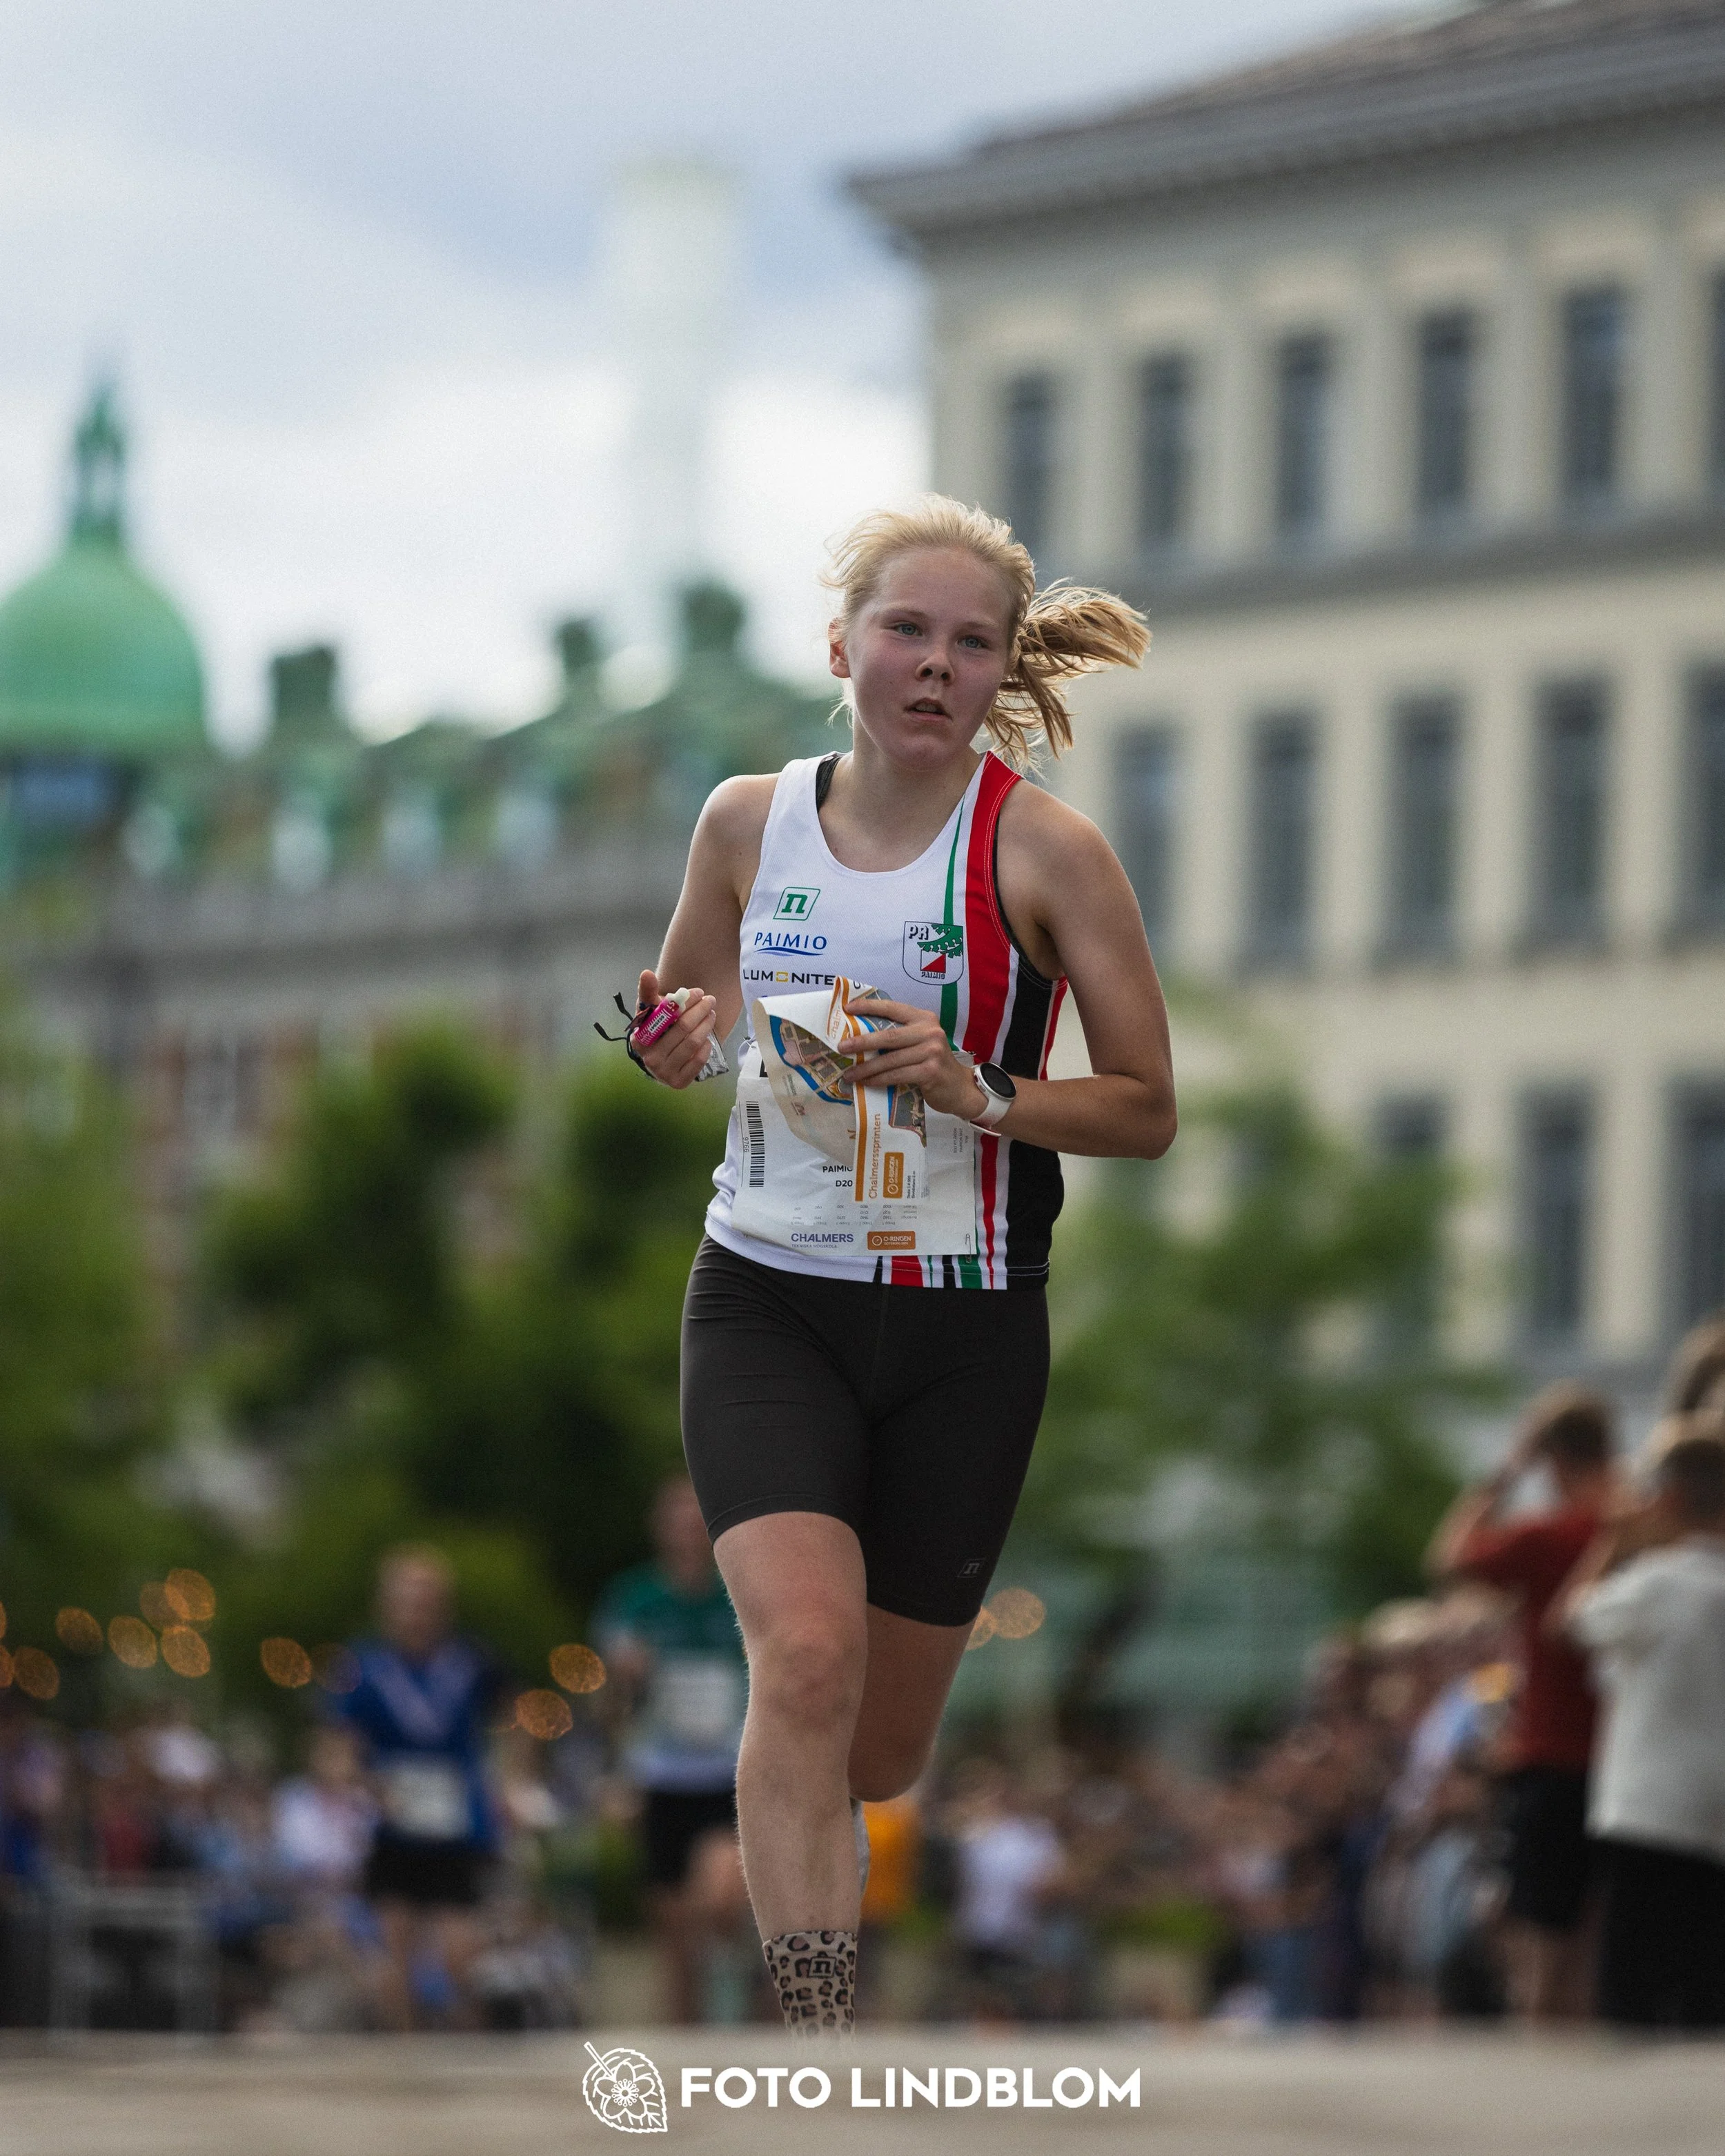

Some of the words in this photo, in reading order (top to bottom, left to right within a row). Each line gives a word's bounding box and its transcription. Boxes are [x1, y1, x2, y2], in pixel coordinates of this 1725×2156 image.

[753, 932, 827, 950] PAIMIO
[869, 1113, 882, 1199] Chalmerssprinten
[791, 1233, 854, 1243] CHALMERS
